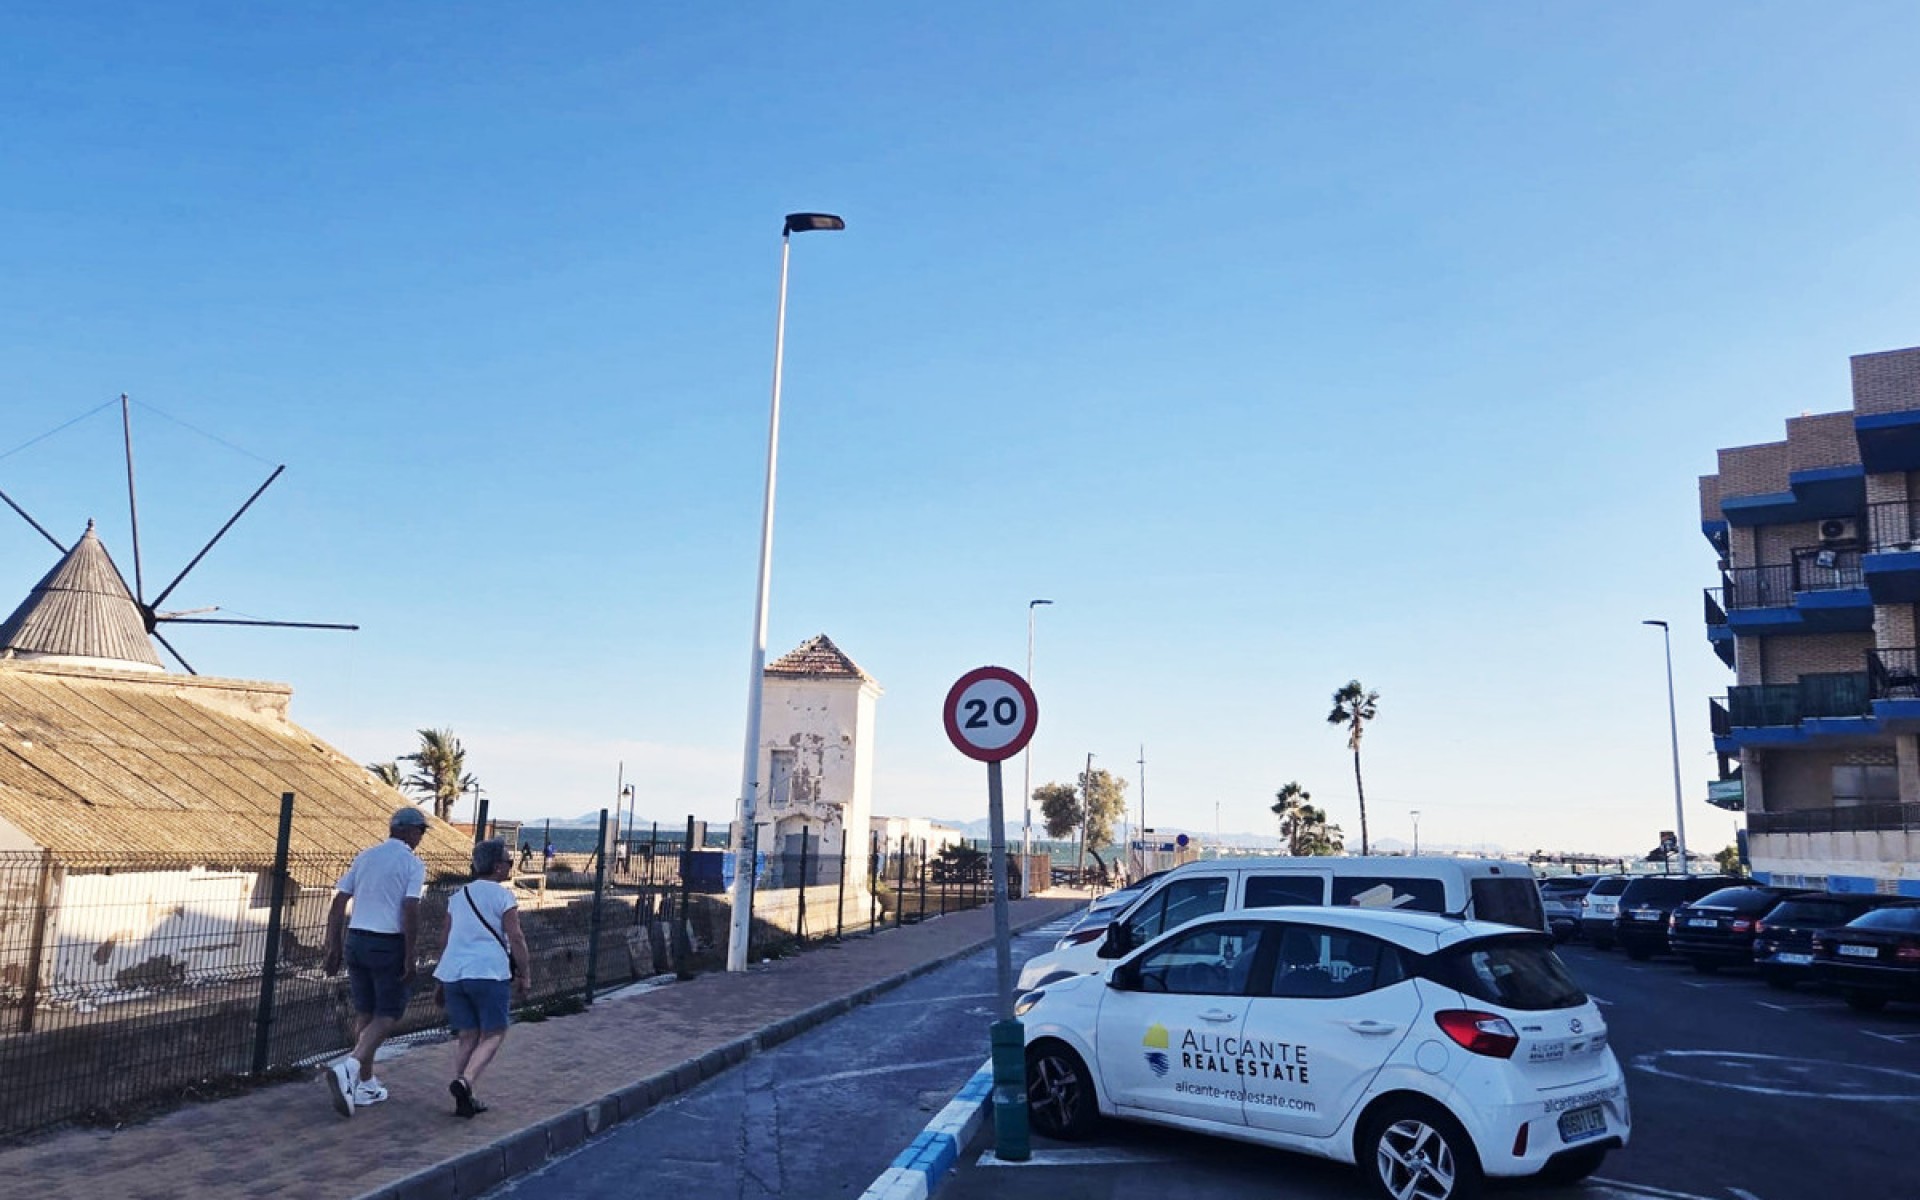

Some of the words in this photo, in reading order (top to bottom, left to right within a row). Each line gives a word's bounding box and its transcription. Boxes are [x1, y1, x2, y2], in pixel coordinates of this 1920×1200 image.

[964, 697, 1017, 729] 20
[1181, 1028, 1308, 1065] ALICANTE
[1182, 1052, 1230, 1073] REAL
[1235, 1058, 1310, 1084] ESTATE
[1175, 1081, 1316, 1112] alicante-realestate.com
